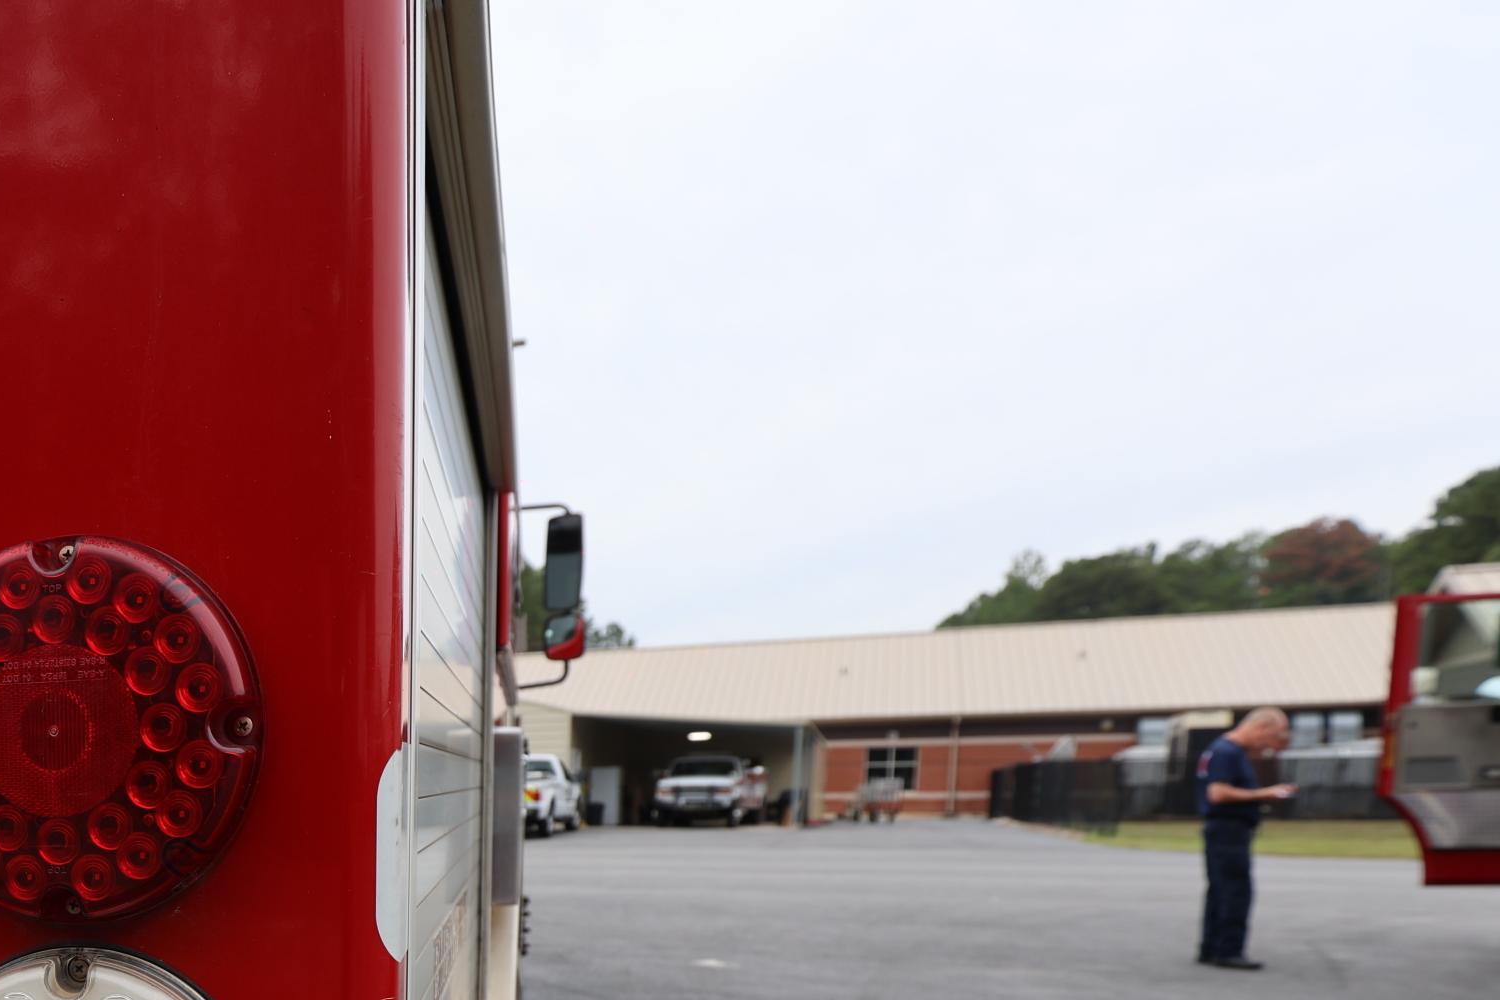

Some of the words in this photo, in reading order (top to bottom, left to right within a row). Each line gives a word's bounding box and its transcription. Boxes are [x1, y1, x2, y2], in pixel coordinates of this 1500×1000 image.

[41, 583, 62, 593] TOP
[2, 661, 19, 670] DOT
[2, 674, 19, 683] DOT
